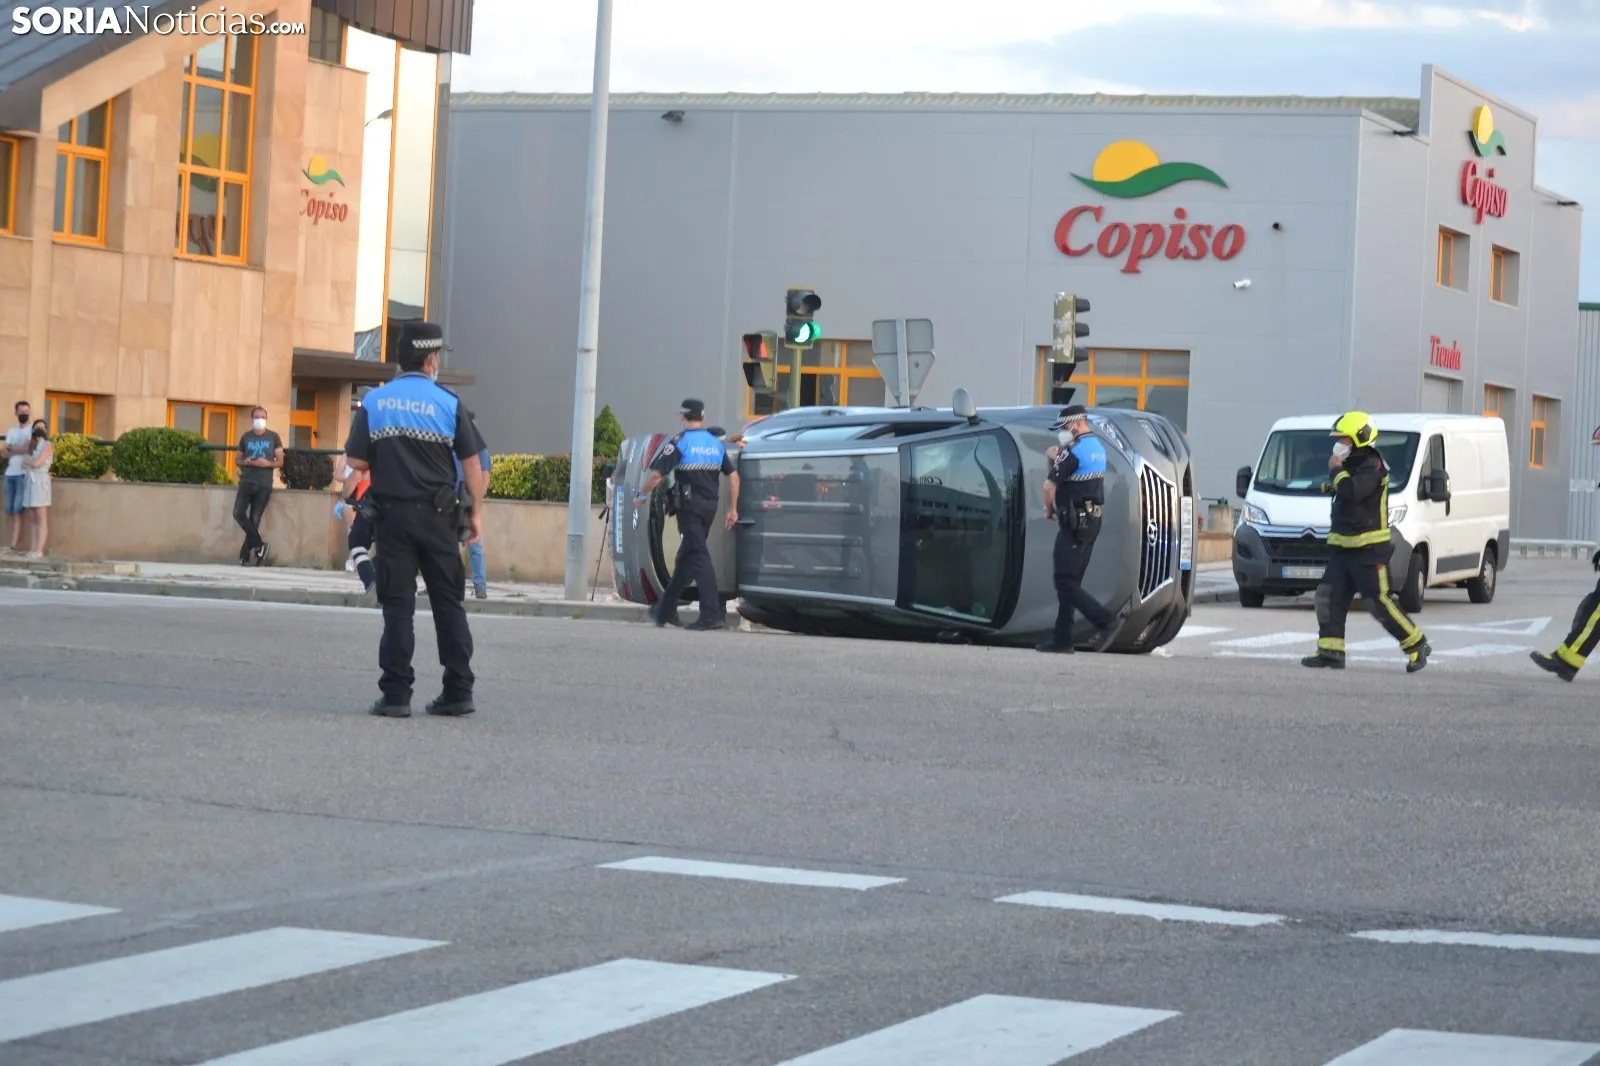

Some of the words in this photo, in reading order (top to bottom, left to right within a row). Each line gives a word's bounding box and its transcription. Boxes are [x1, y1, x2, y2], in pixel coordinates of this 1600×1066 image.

[1460, 160, 1508, 224] Copiso
[1054, 205, 1246, 274] Copiso
[1429, 334, 1462, 371] Tienda
